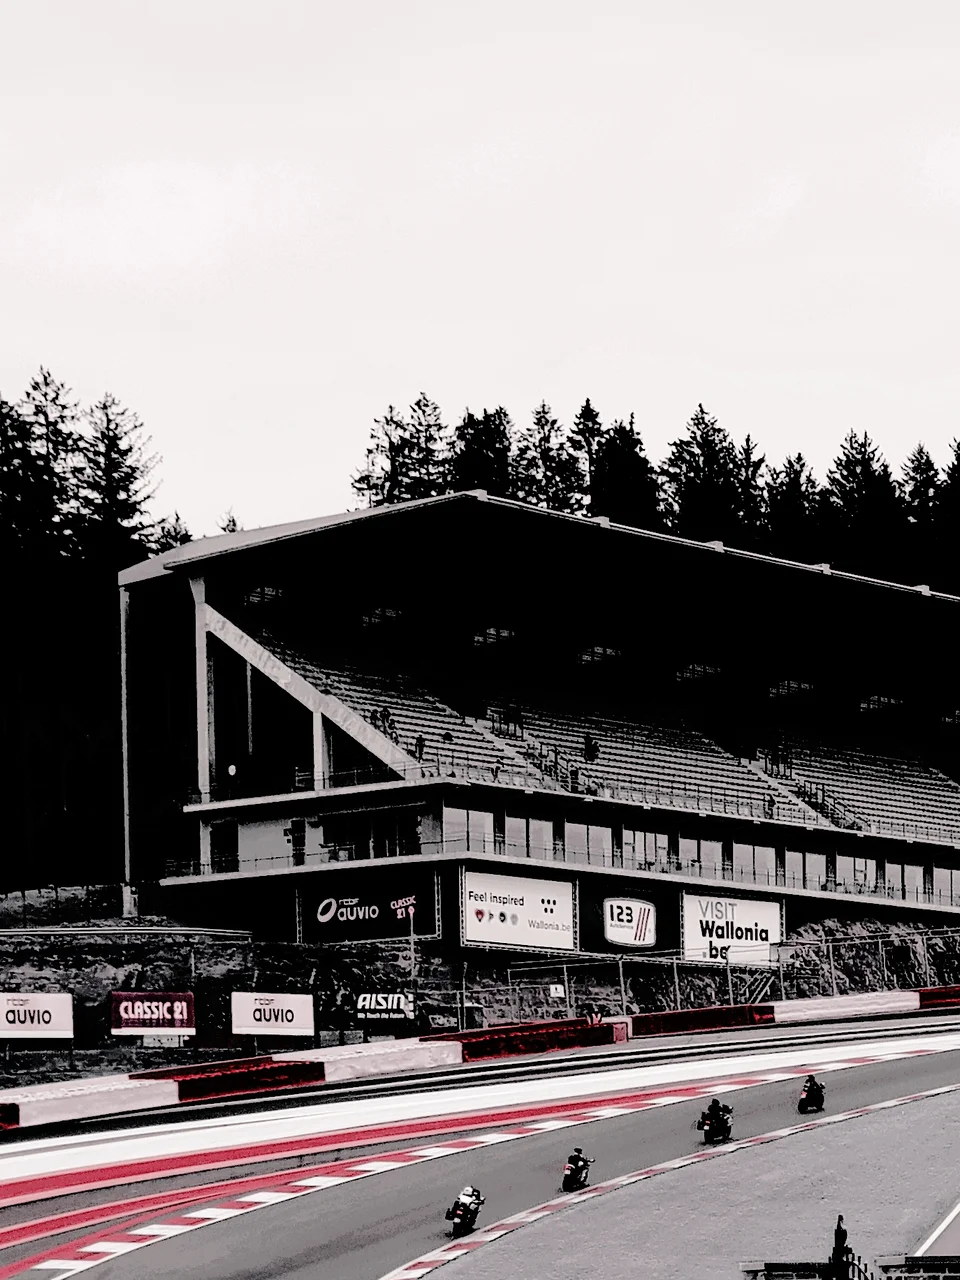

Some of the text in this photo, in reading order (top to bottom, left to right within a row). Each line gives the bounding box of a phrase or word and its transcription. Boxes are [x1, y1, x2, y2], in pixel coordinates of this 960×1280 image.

[468, 890, 524, 906] Feel inspired
[609, 904, 634, 923] 123
[698, 899, 738, 920] VISIT
[528, 919, 571, 932] Wallonia.be
[699, 919, 769, 942] Wallonia
[119, 1001, 188, 1020] CLASSIC 21
